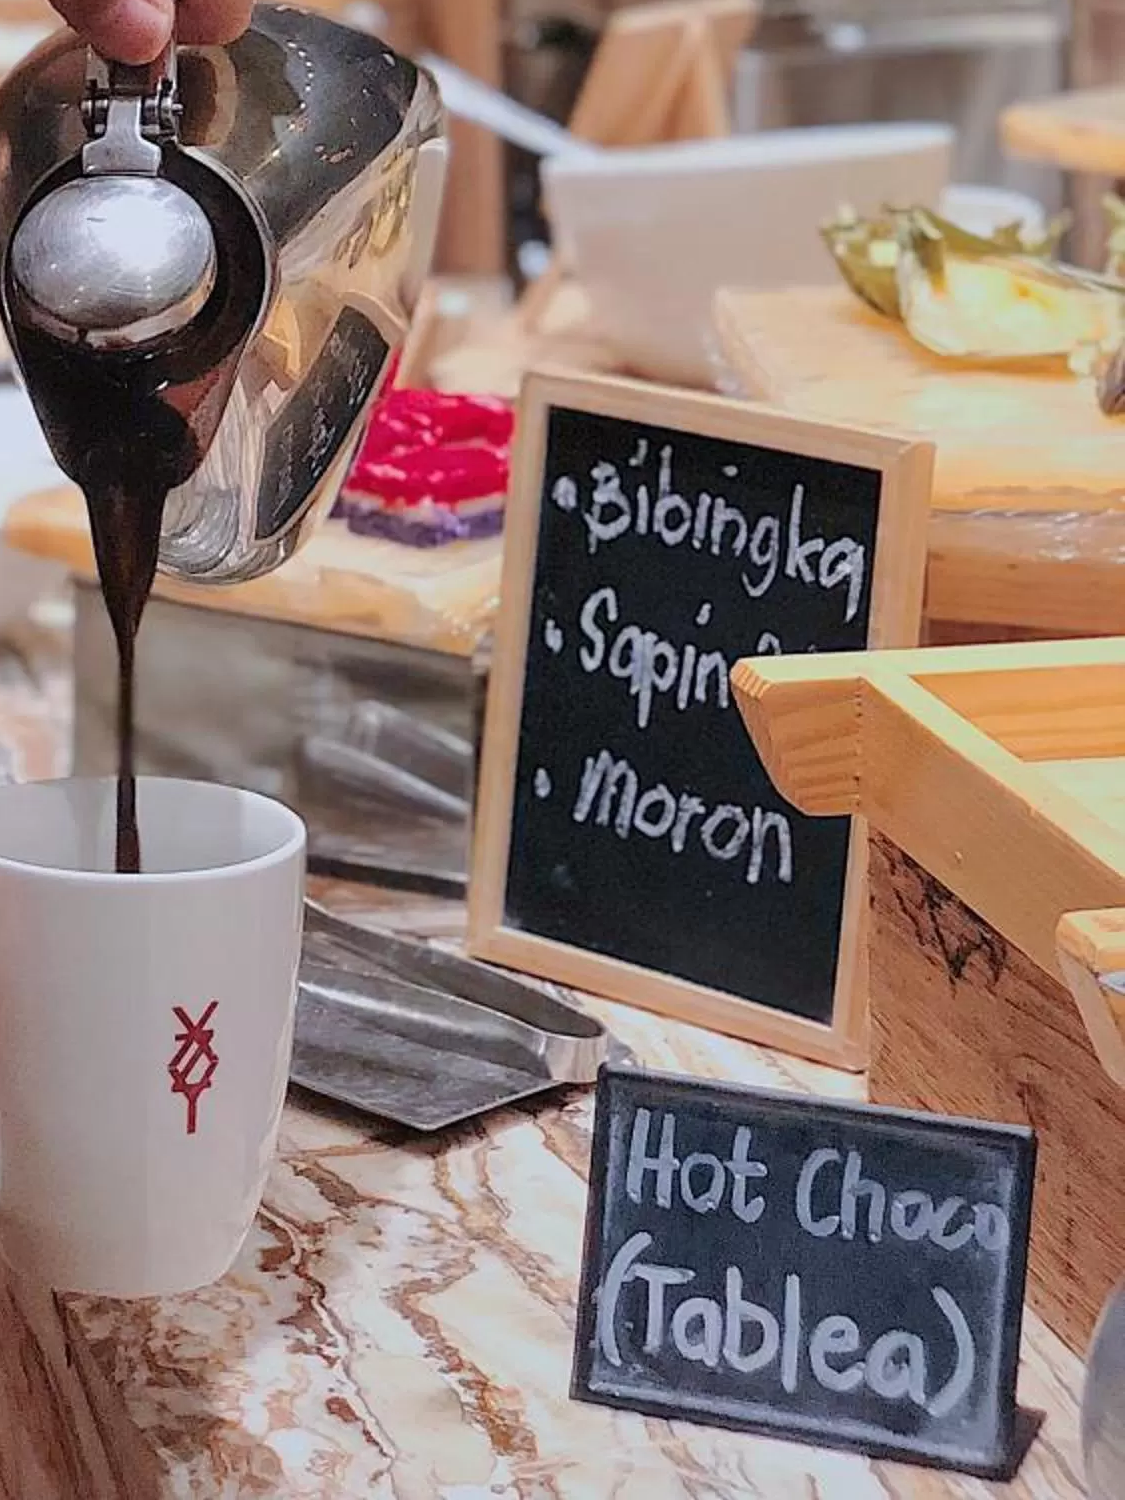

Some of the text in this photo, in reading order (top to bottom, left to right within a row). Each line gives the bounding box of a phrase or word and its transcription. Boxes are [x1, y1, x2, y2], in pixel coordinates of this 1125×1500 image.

[584, 438, 865, 623] Bibingka
[579, 587, 729, 728] Sapin
[626, 1108, 1009, 1251] Hot Choco
[597, 1231, 975, 1417] (Tablea)
